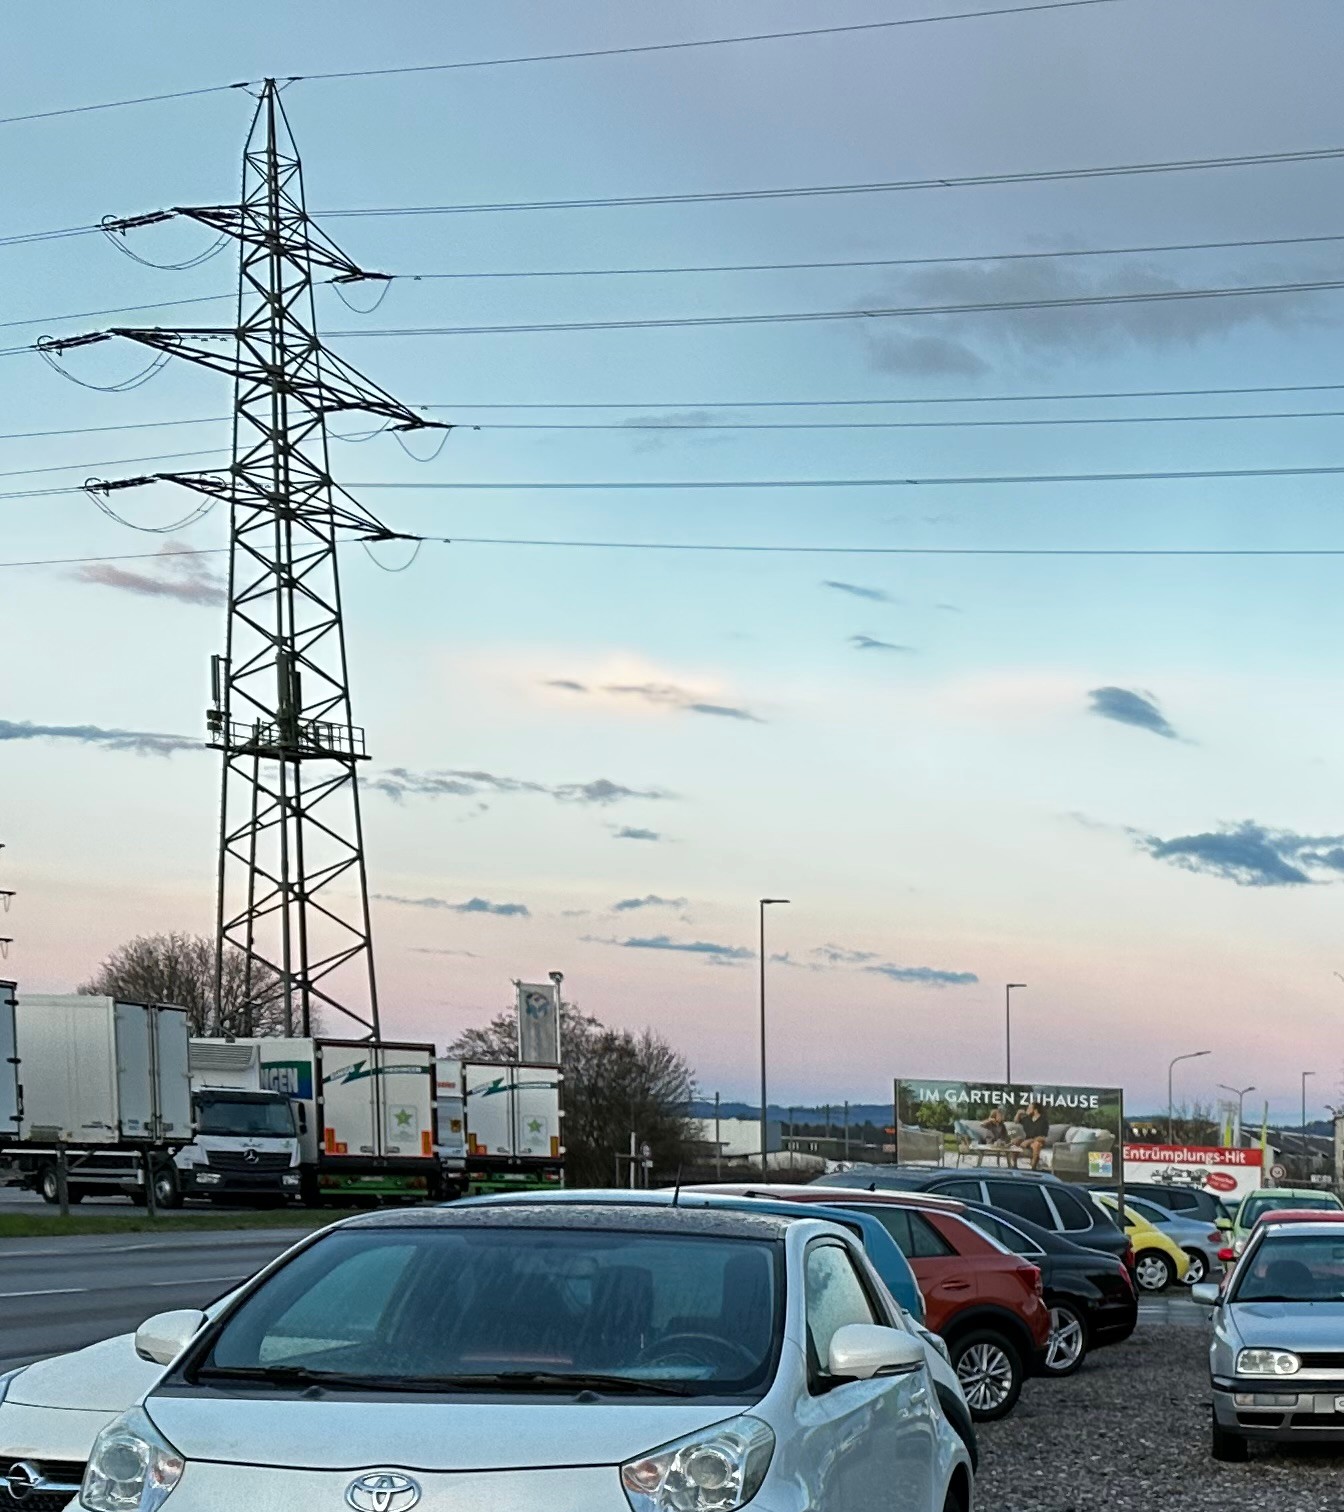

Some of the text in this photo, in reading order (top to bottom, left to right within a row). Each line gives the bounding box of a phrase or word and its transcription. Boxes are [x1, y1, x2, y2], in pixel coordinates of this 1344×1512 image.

[919, 1088, 940, 1102] IM
[944, 1089, 1015, 1105] GARTEN
[1123, 1146, 1246, 1165] Entrümplungs-Hit
